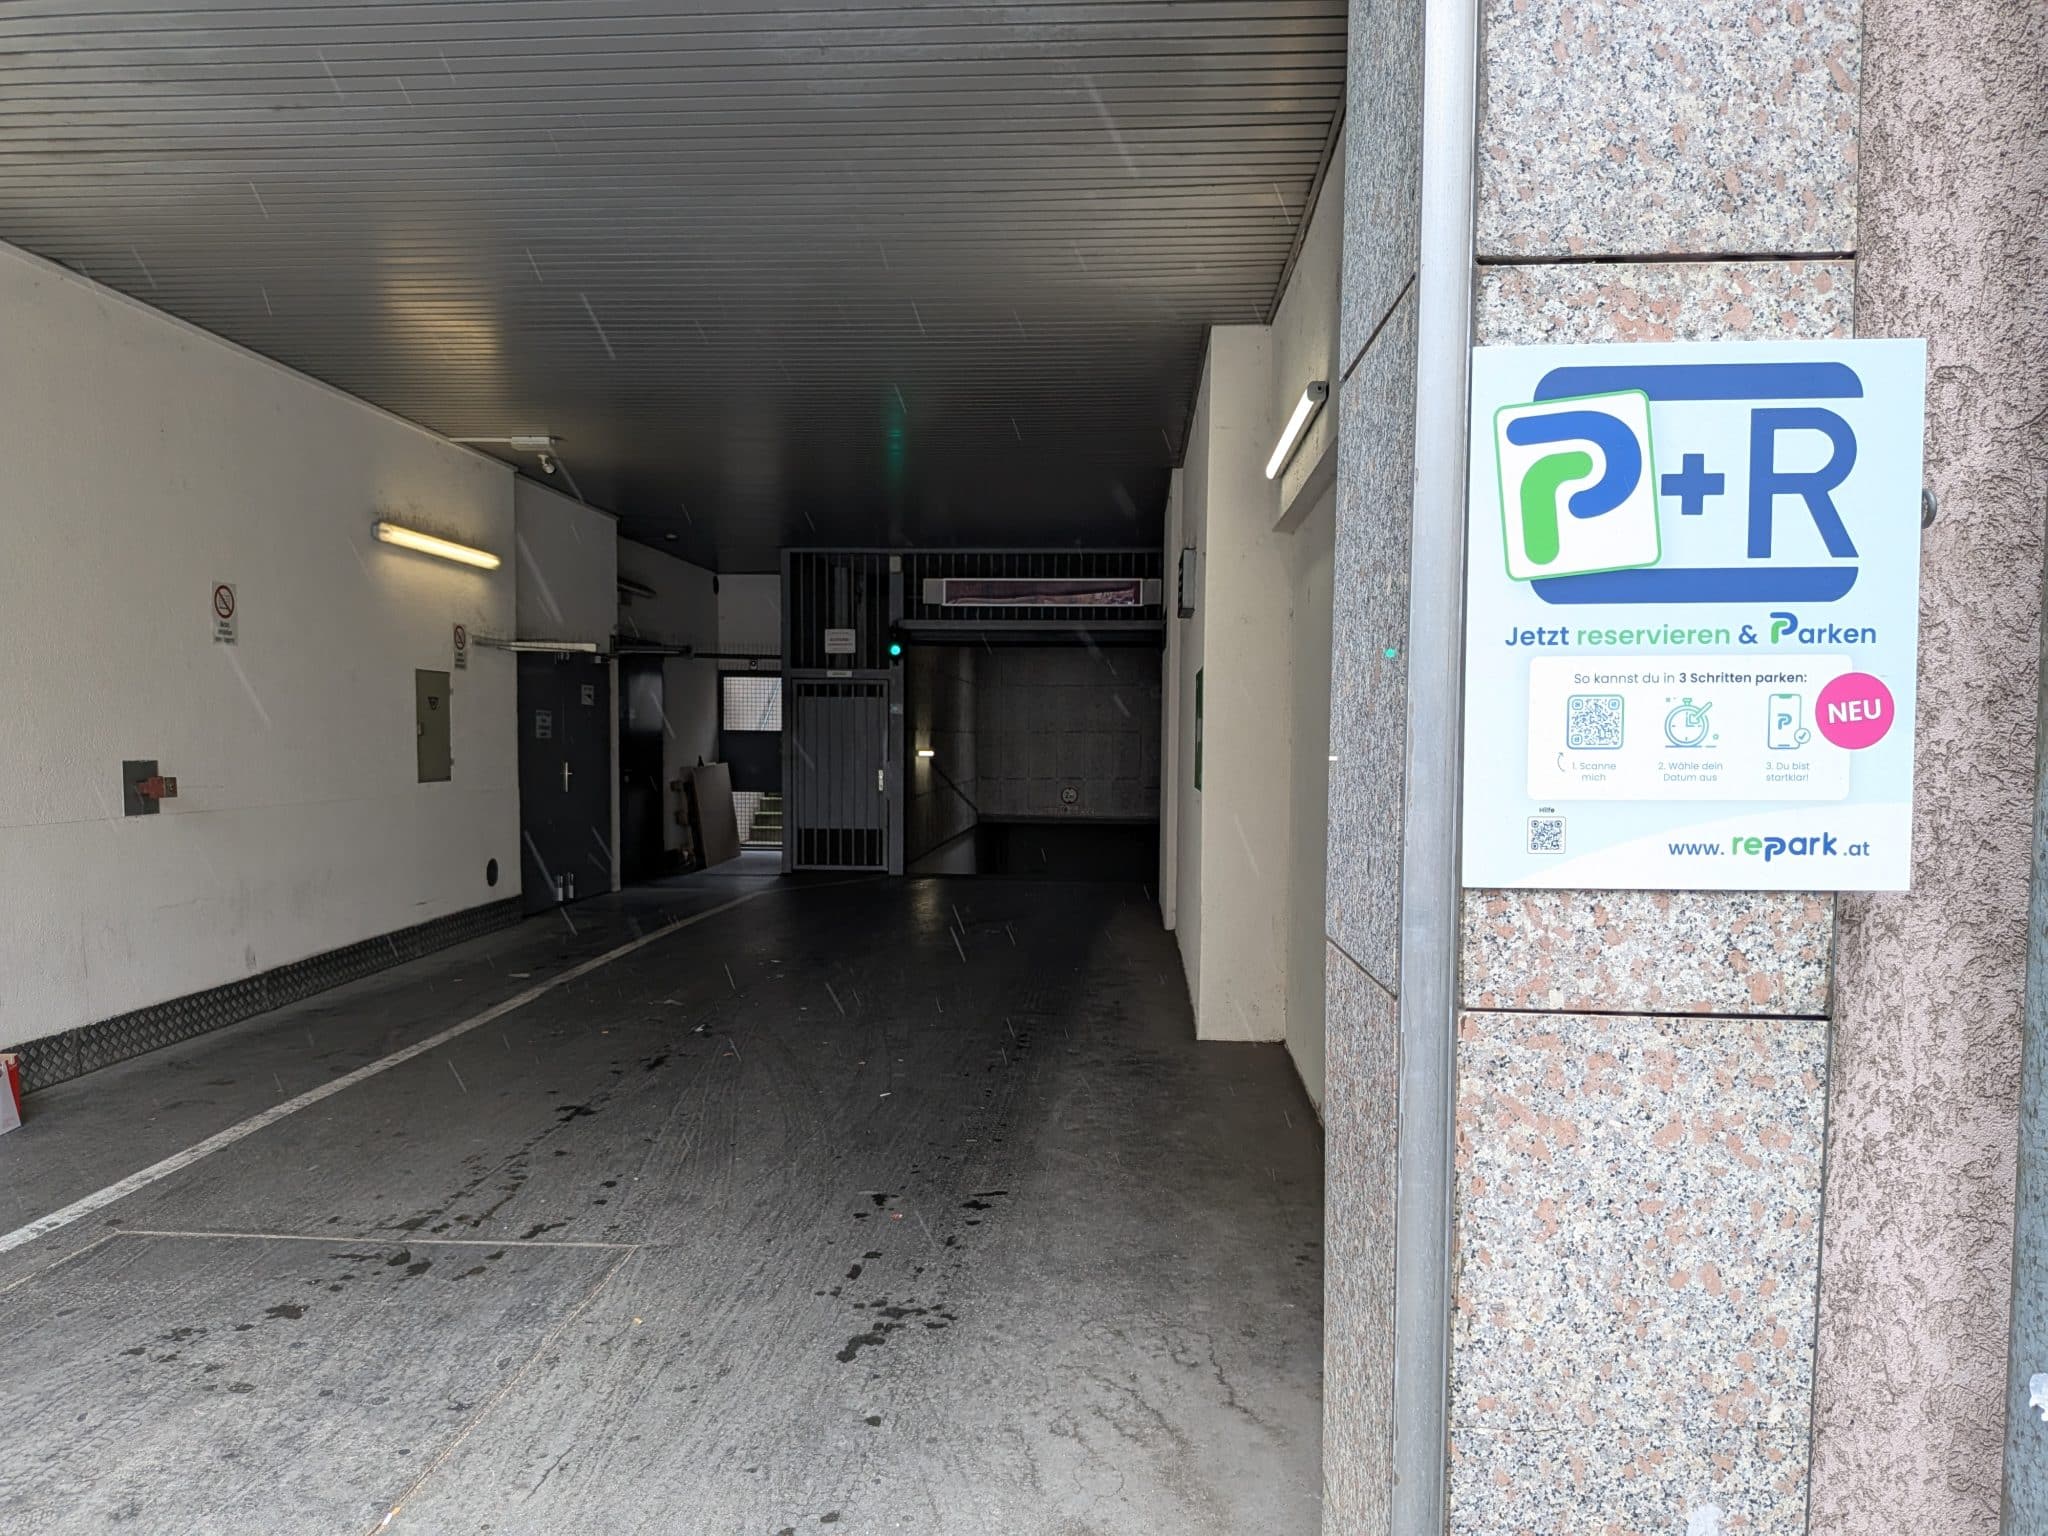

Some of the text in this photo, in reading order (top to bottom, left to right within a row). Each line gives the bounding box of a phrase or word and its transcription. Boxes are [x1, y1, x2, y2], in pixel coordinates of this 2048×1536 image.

[1505, 611, 1877, 647] Jetzt reservieren & Parken
[1574, 671, 1808, 686] So kannst du in 3 Schritten parken:
[1827, 698, 1882, 724] NEU
[1579, 762, 1617, 771] Scanne
[1657, 761, 1724, 771] 2. Wähle dein
[1765, 761, 1810, 771] 3. Du bist
[1581, 773, 1607, 782] mich
[1663, 773, 1718, 782] Datum aus
